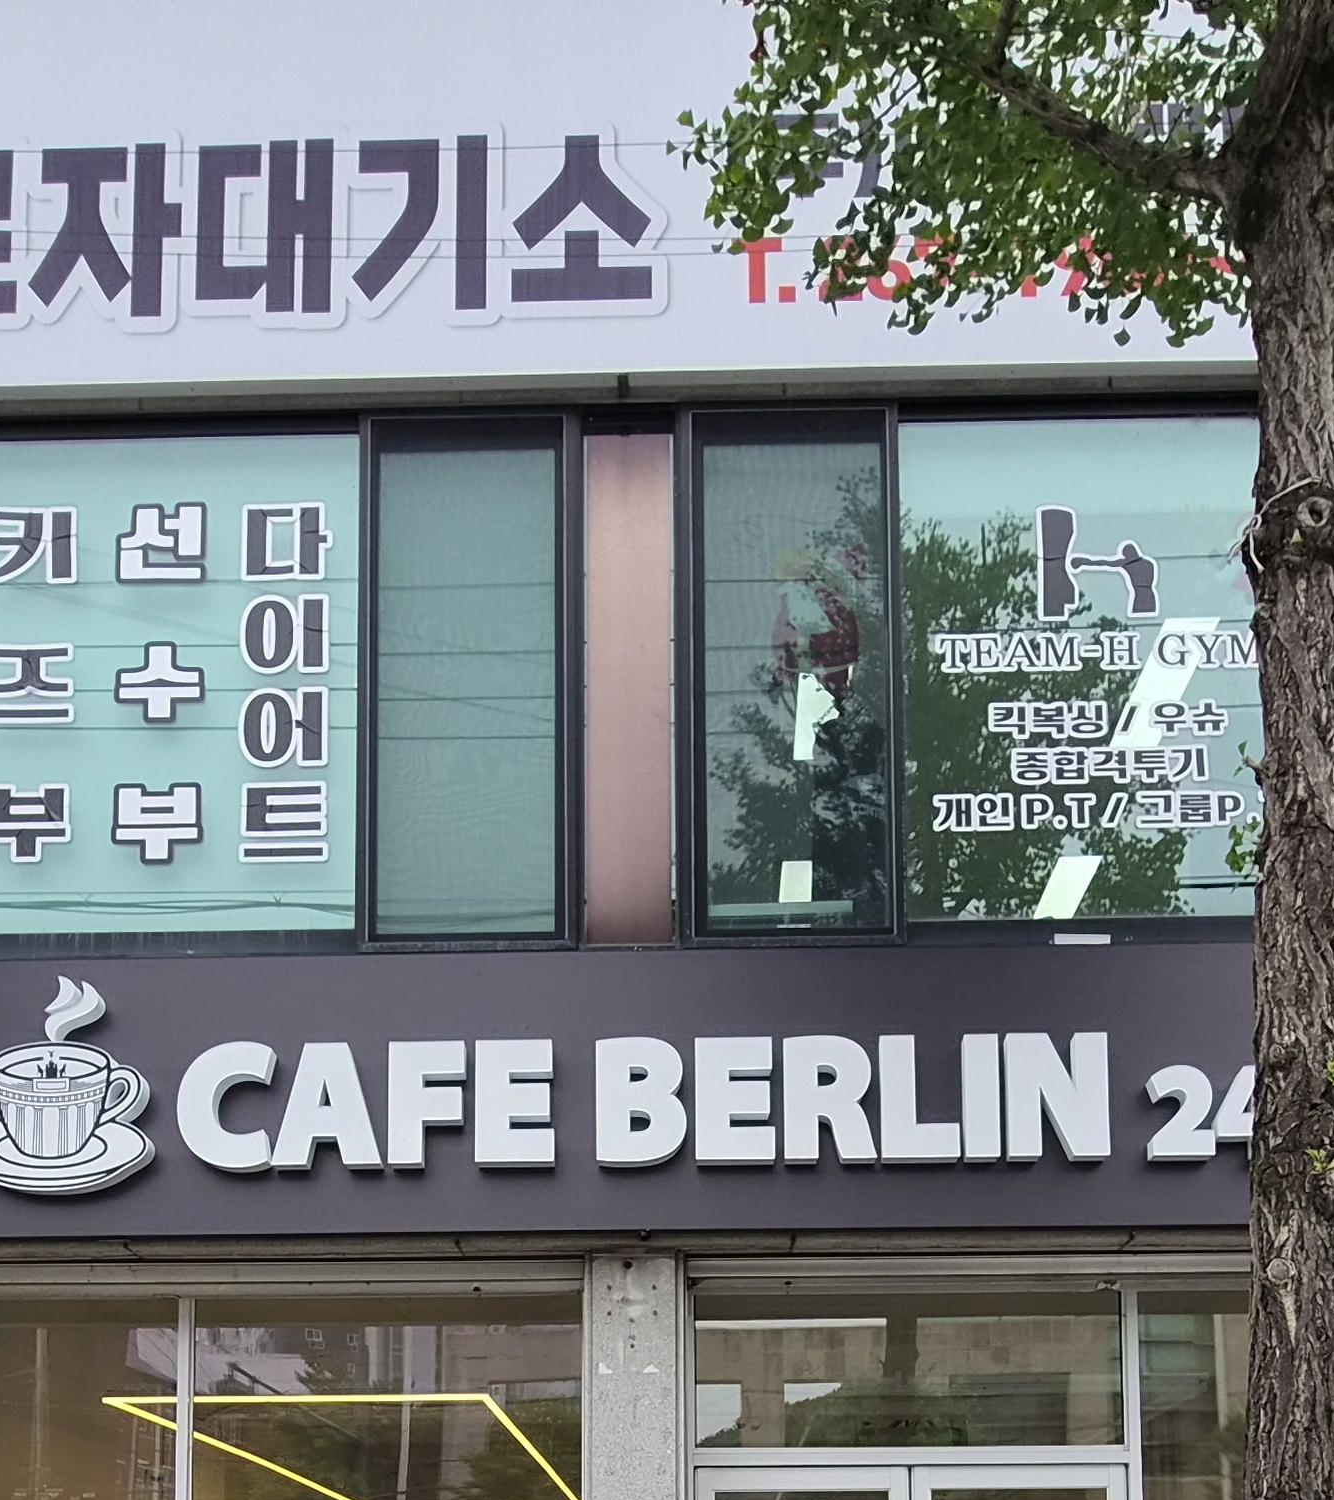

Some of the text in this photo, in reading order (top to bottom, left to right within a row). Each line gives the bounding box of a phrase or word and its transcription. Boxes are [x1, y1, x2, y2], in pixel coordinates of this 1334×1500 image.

[935, 632, 1260, 673] TEAM-H GYM
[238, 500, 334, 864] 다이어트
[988, 701, 1108, 739] 킥복싱
[1150, 698, 1229, 738] 우슈
[1011, 745, 1210, 786] 종합격투기
[932, 793, 1015, 832] 개인
[1023, 791, 1096, 830] P.T
[1136, 789, 1265, 830] 그룹P.
[177, 1037, 557, 1173] CAFE
[594, 1031, 1112, 1167] BERLIN
